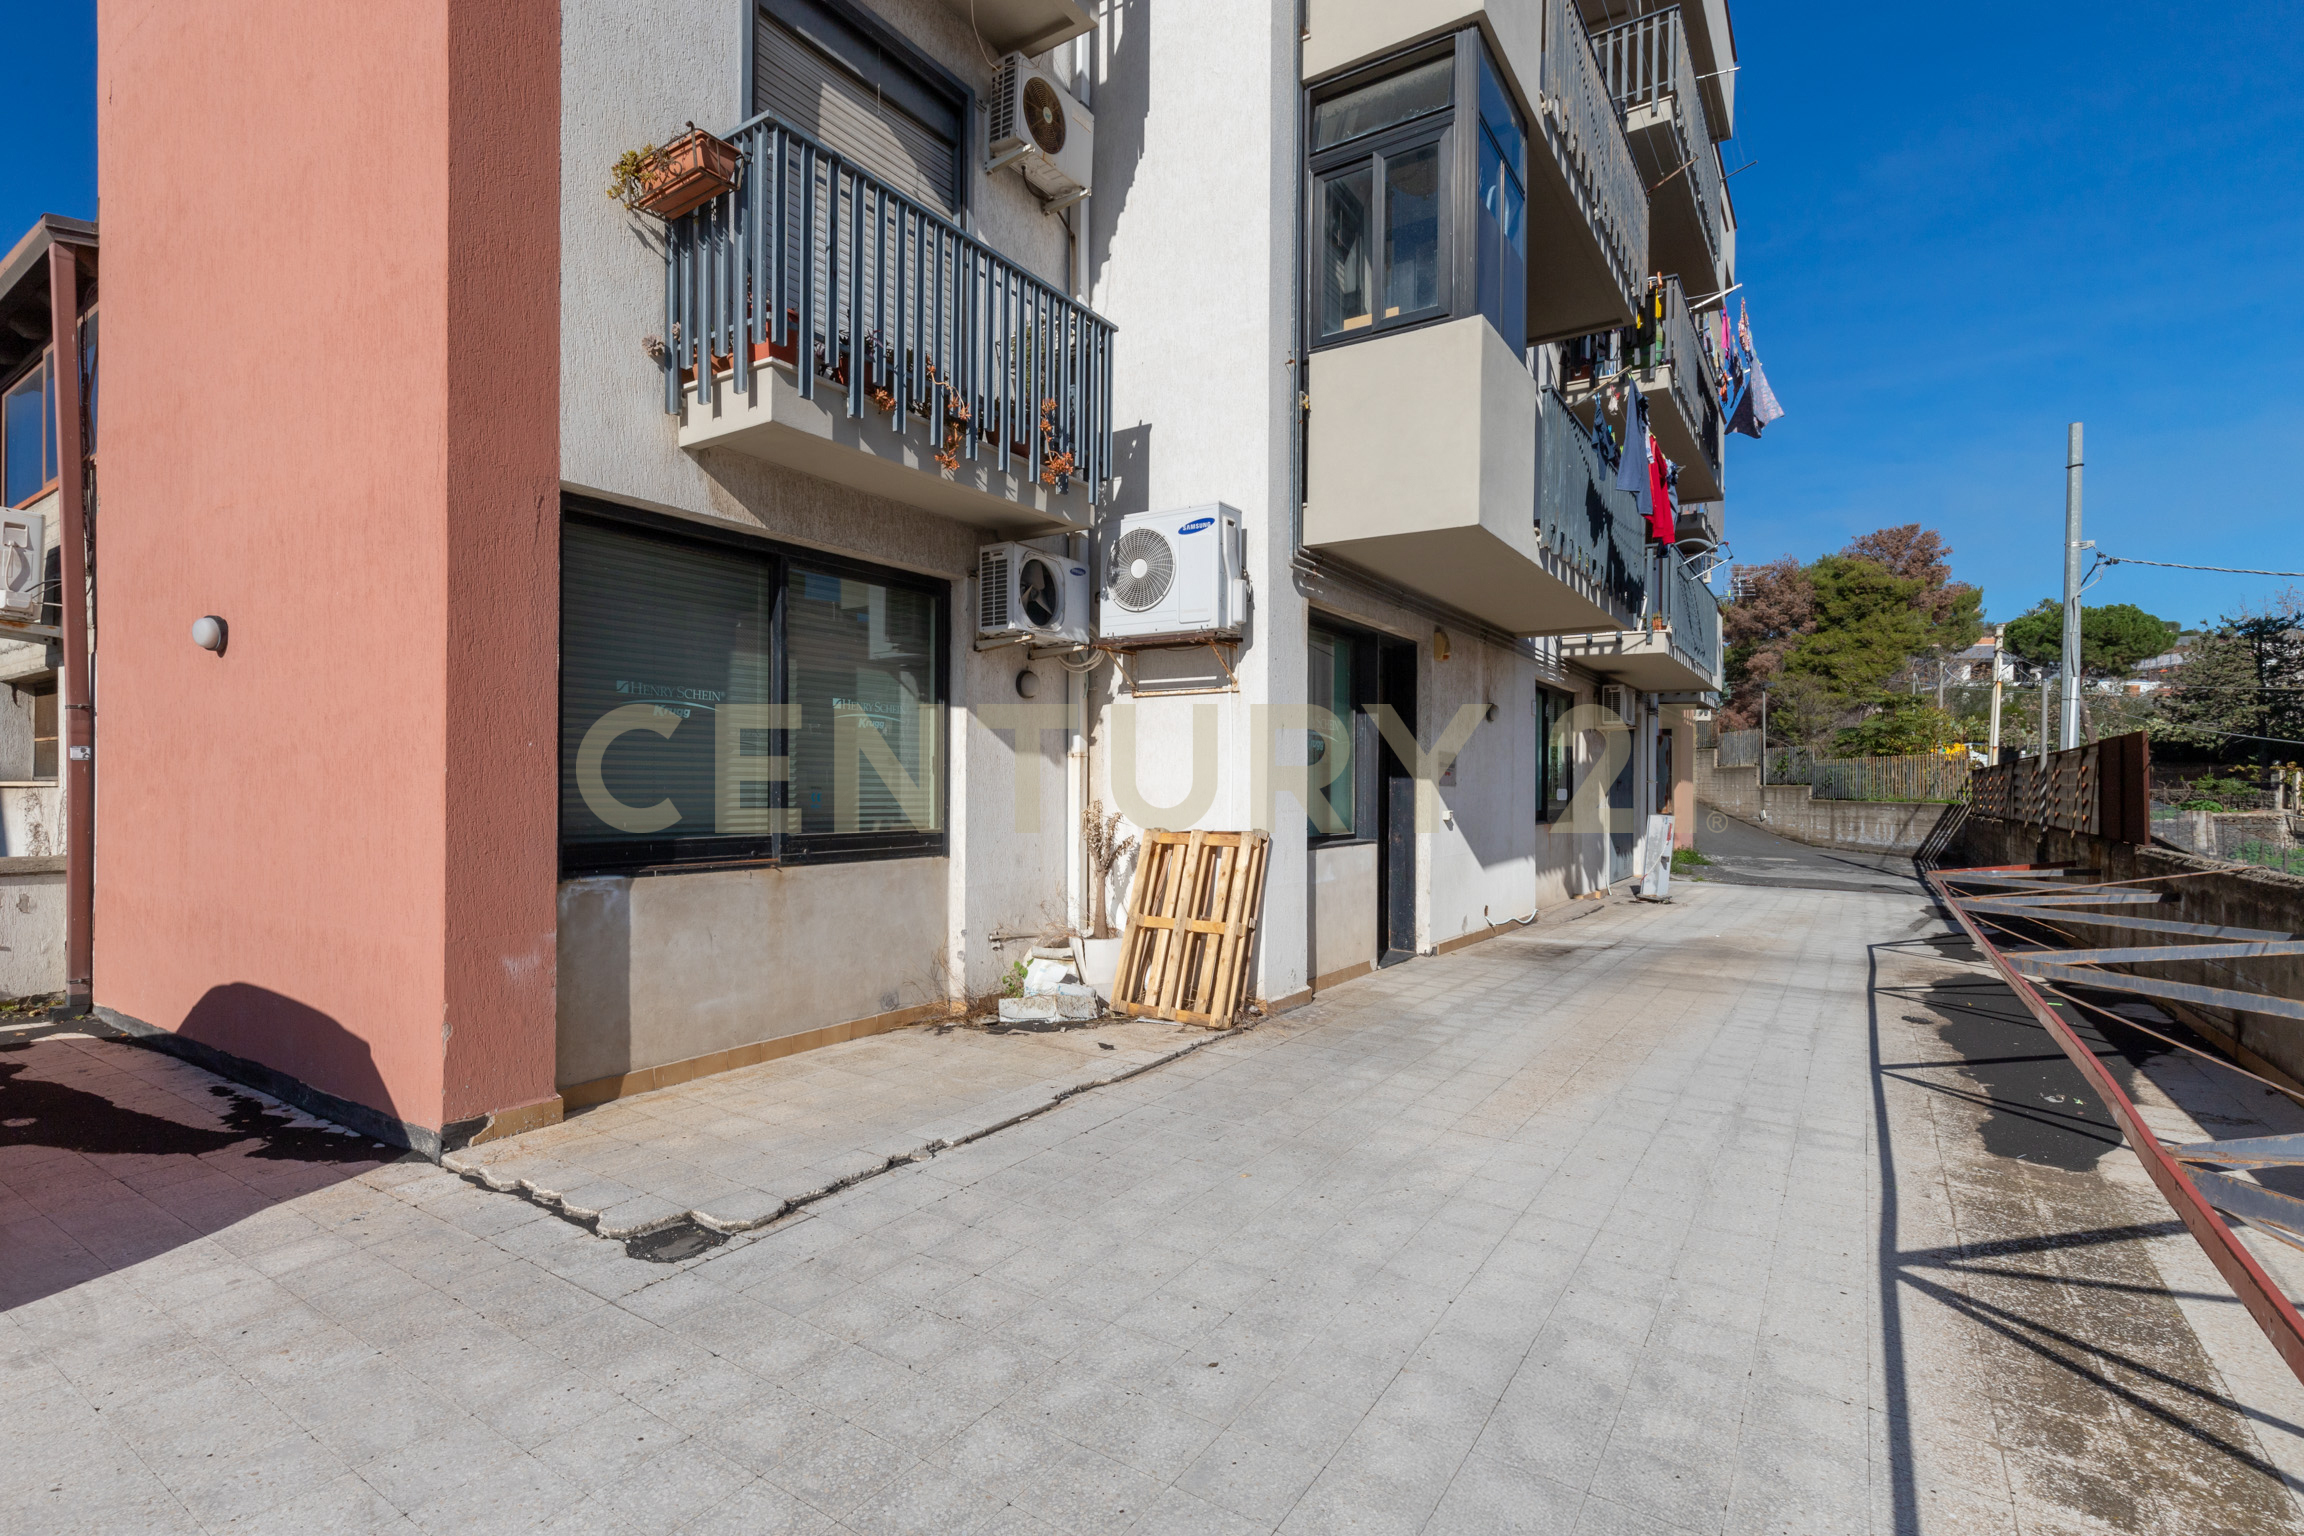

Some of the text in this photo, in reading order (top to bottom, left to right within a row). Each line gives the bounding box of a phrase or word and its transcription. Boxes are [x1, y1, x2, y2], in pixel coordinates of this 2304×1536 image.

[1182, 521, 1211, 531] SAMSUNG
[630, 681, 676, 698] HENRY
[652, 704, 690, 718] Krugg
[842, 698, 874, 712] HENRY
[858, 717, 886, 730] Krugg
